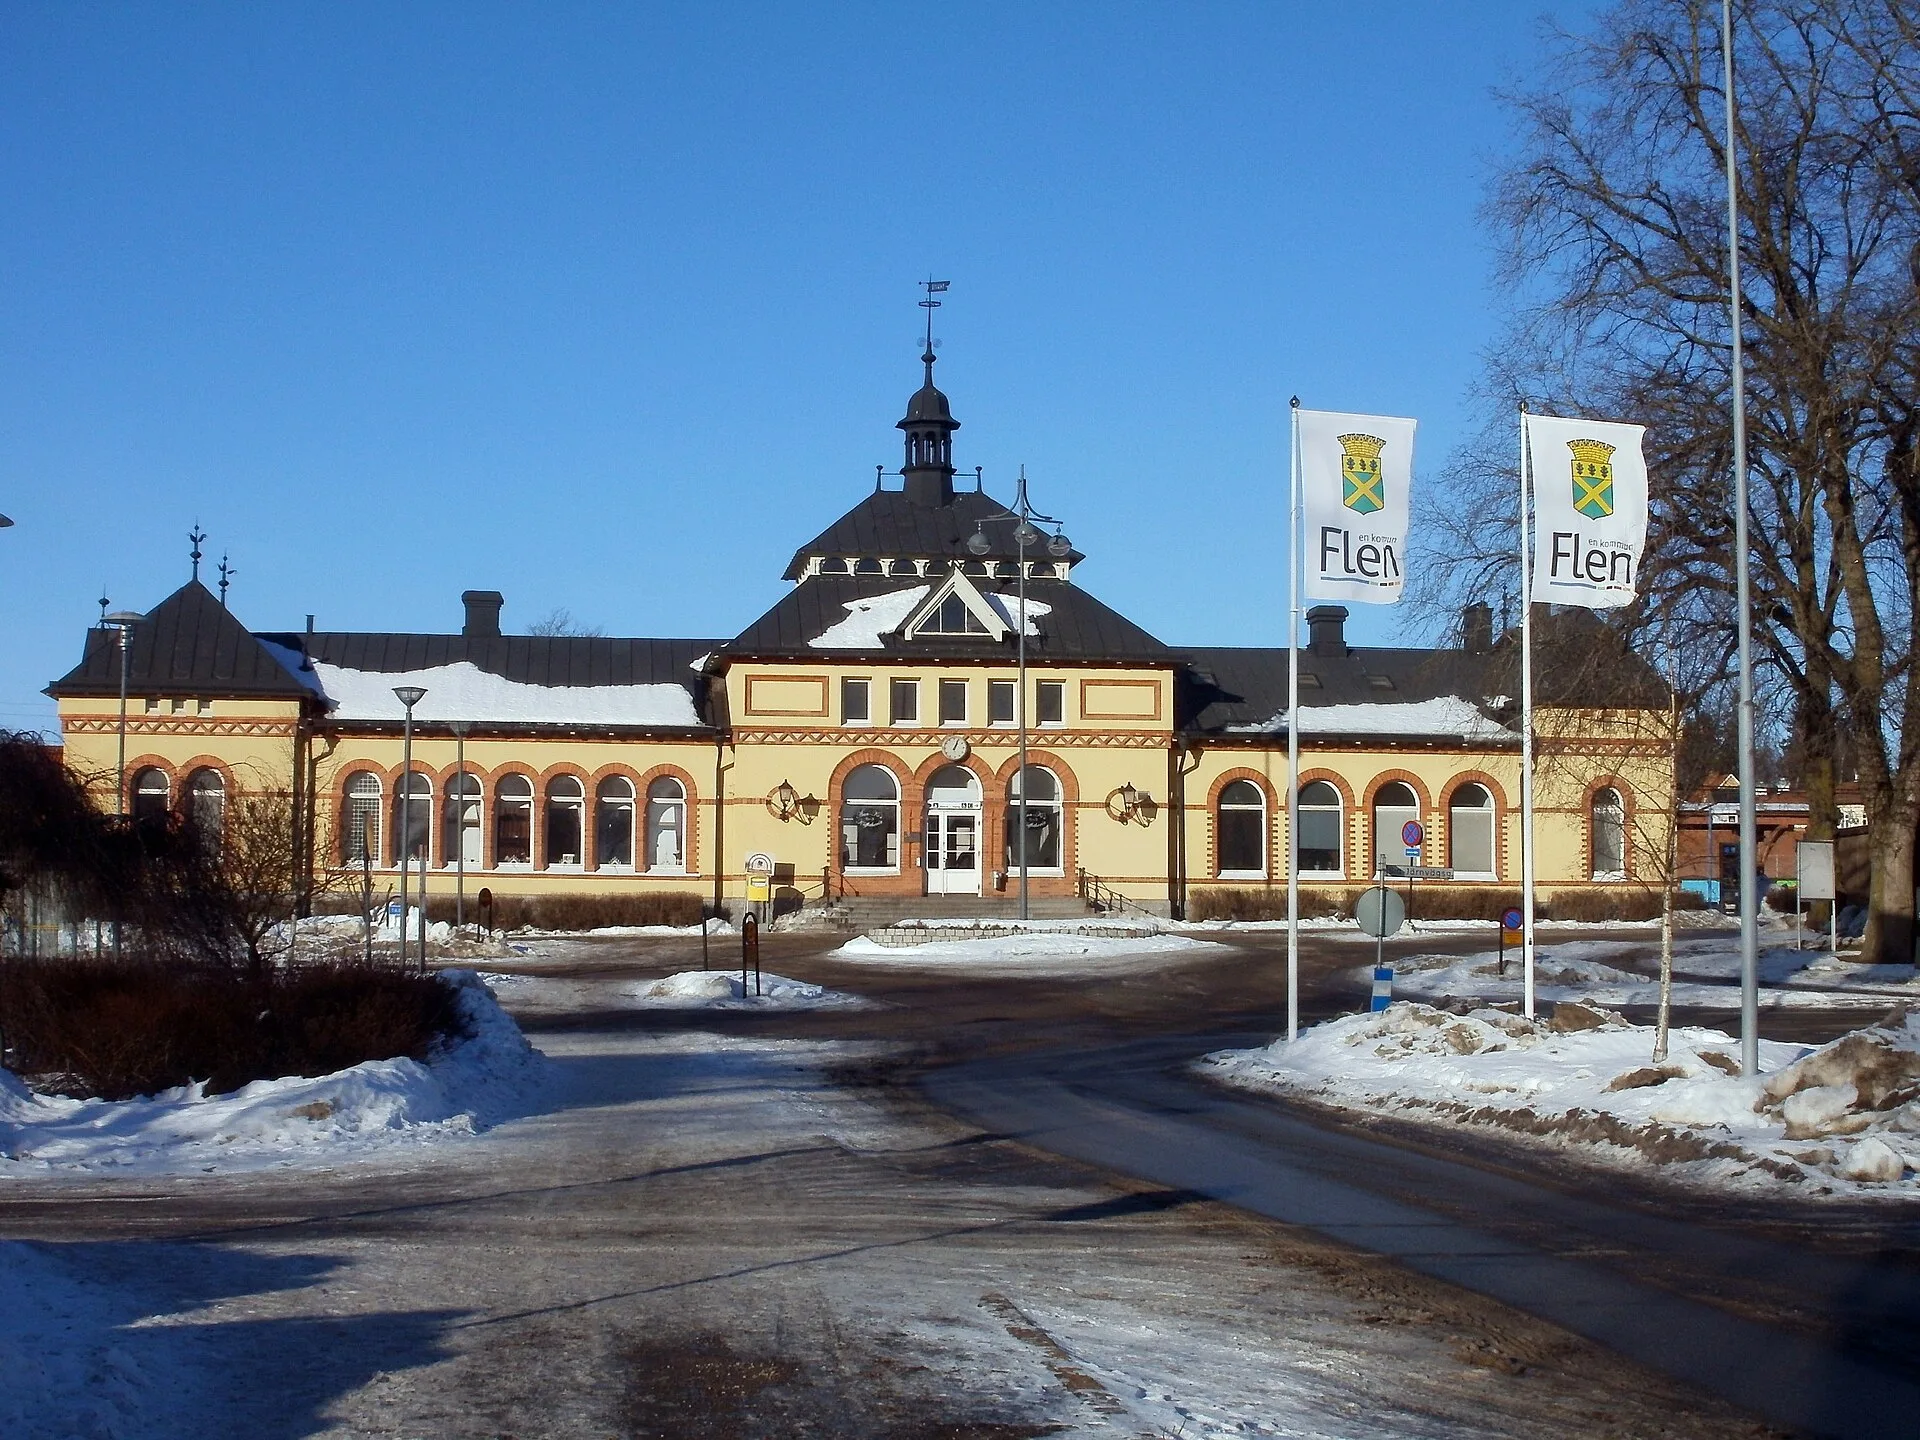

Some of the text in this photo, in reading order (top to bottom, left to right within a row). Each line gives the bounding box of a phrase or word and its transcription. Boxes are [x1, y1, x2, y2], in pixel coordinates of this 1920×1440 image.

[1321, 527, 1399, 578] Flen
[1358, 534, 1369, 542] en
[1589, 539, 1633, 550] en kommun
[1551, 532, 1631, 583] Flen
